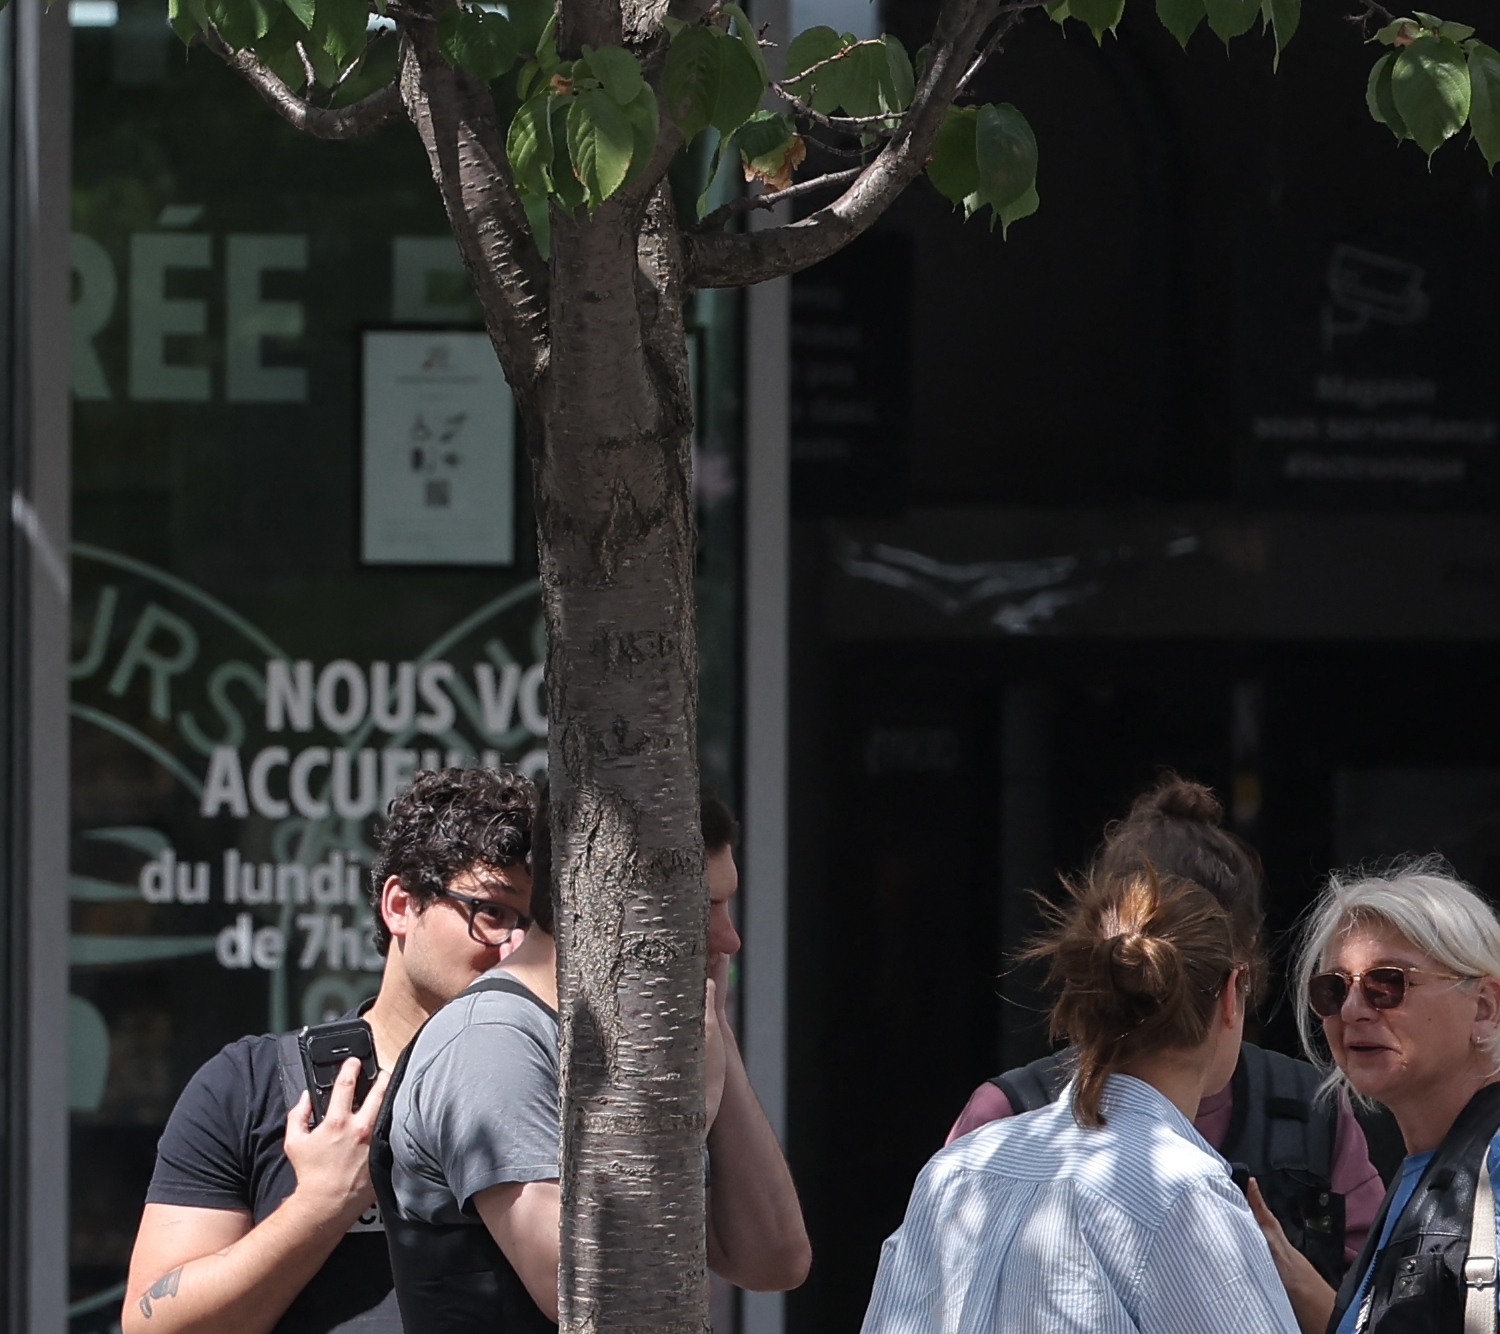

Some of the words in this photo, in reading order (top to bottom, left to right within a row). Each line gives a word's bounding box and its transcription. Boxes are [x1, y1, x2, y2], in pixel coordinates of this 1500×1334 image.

[265, 659, 455, 733] NOUS
[138, 846, 212, 905] du
[223, 846, 362, 905] lundi
[214, 913, 285, 970] de
